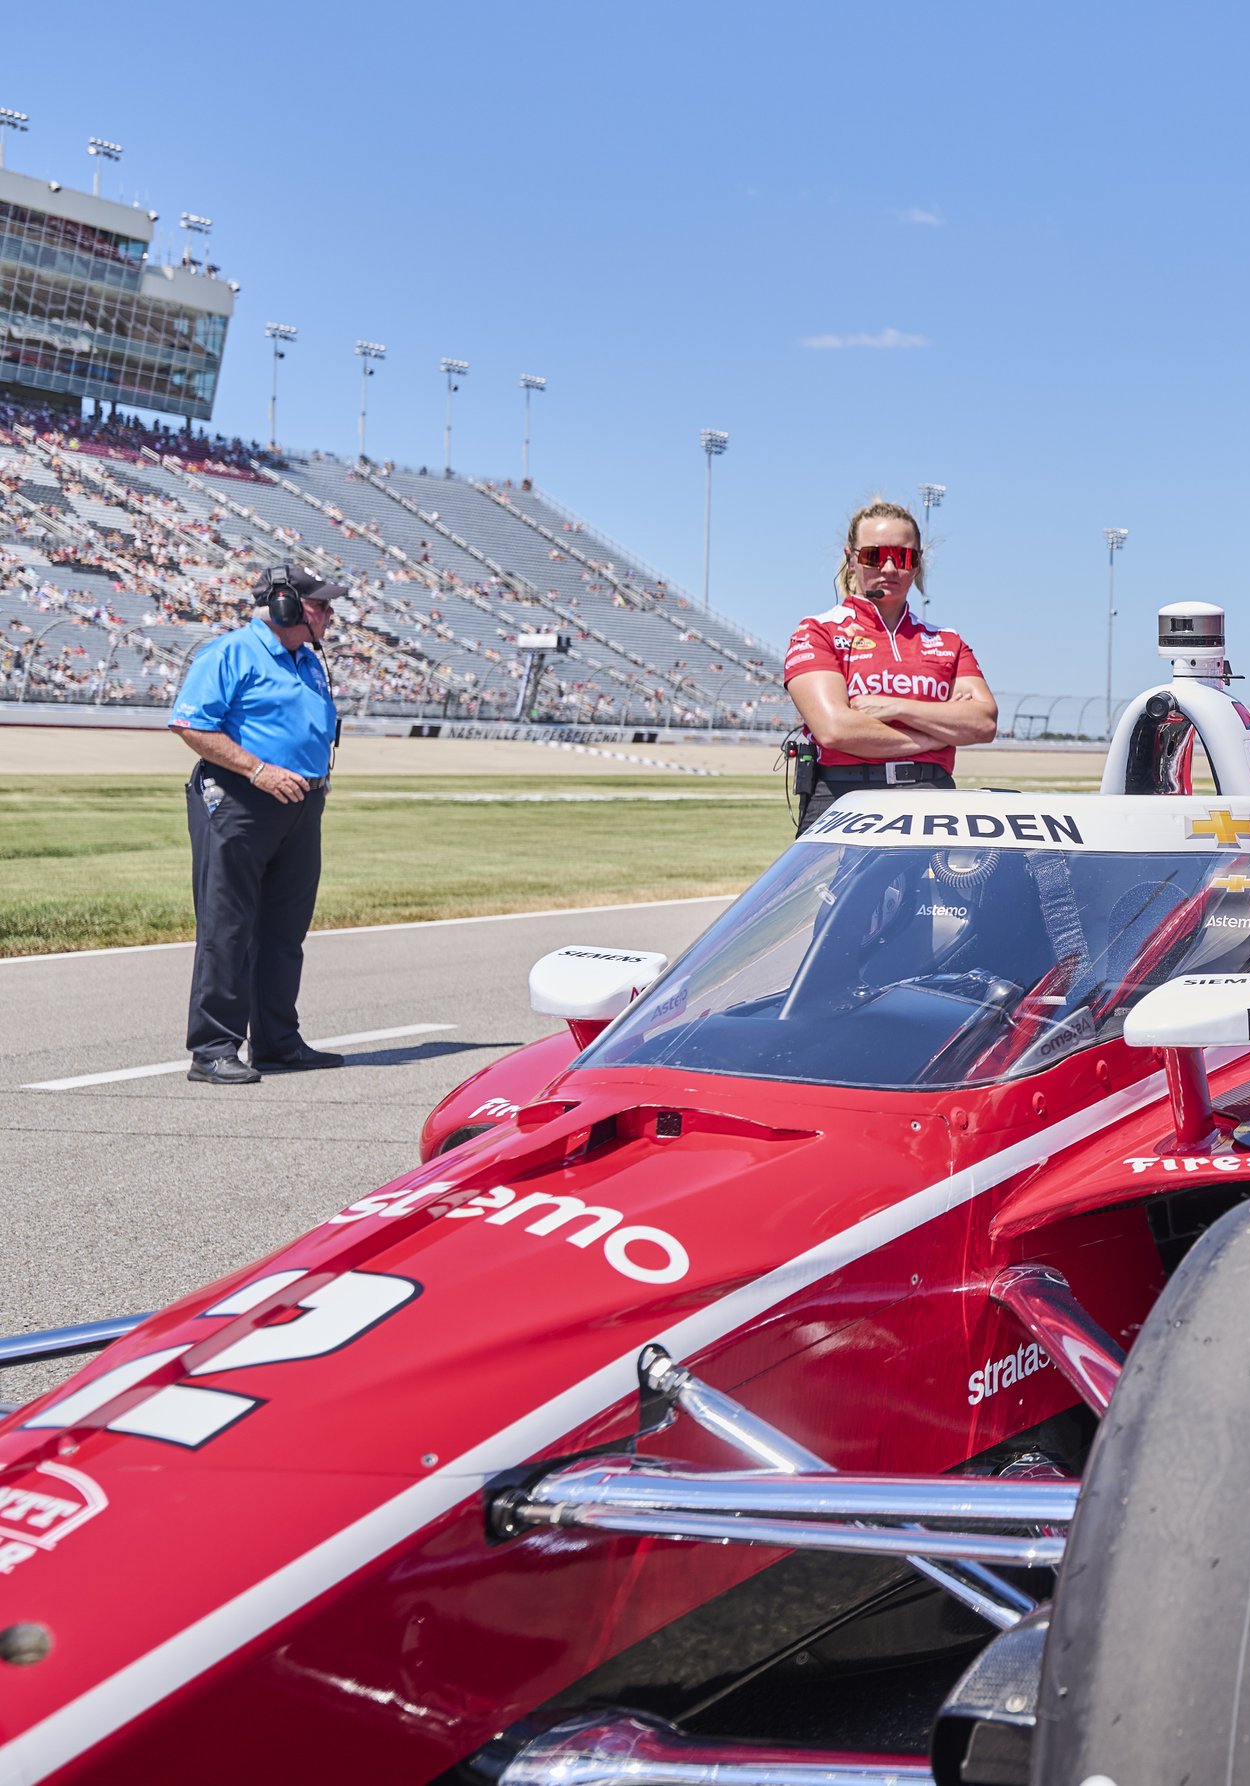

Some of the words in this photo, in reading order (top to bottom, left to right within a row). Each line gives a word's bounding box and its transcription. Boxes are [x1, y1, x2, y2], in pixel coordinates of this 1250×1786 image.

[848, 669, 950, 702] Astemo
[449, 727, 520, 741] NASHVILLE
[916, 904, 968, 917] Astemo
[558, 950, 648, 964] SIEMENS
[327, 1180, 690, 1285] stemo
[968, 1342, 1056, 1406] stratas
